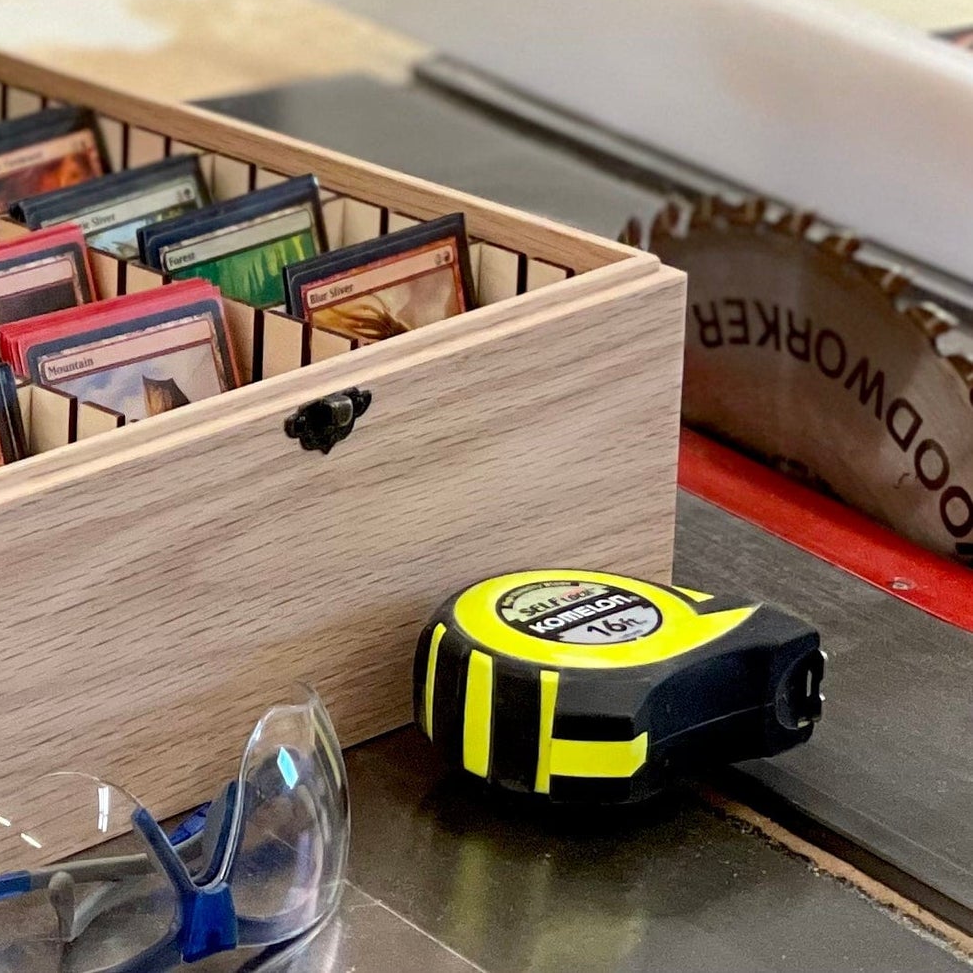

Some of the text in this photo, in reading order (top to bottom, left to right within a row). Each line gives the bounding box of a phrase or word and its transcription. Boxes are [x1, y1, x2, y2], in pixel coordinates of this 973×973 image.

[168, 252, 196, 267] Forest
[329, 283, 354, 298] Sliver
[48, 356, 95, 376] Mountain
[691, 298, 973, 555] OODWORKER
[518, 596, 561, 617] SELF
[529, 593, 633, 634] KOMELON
